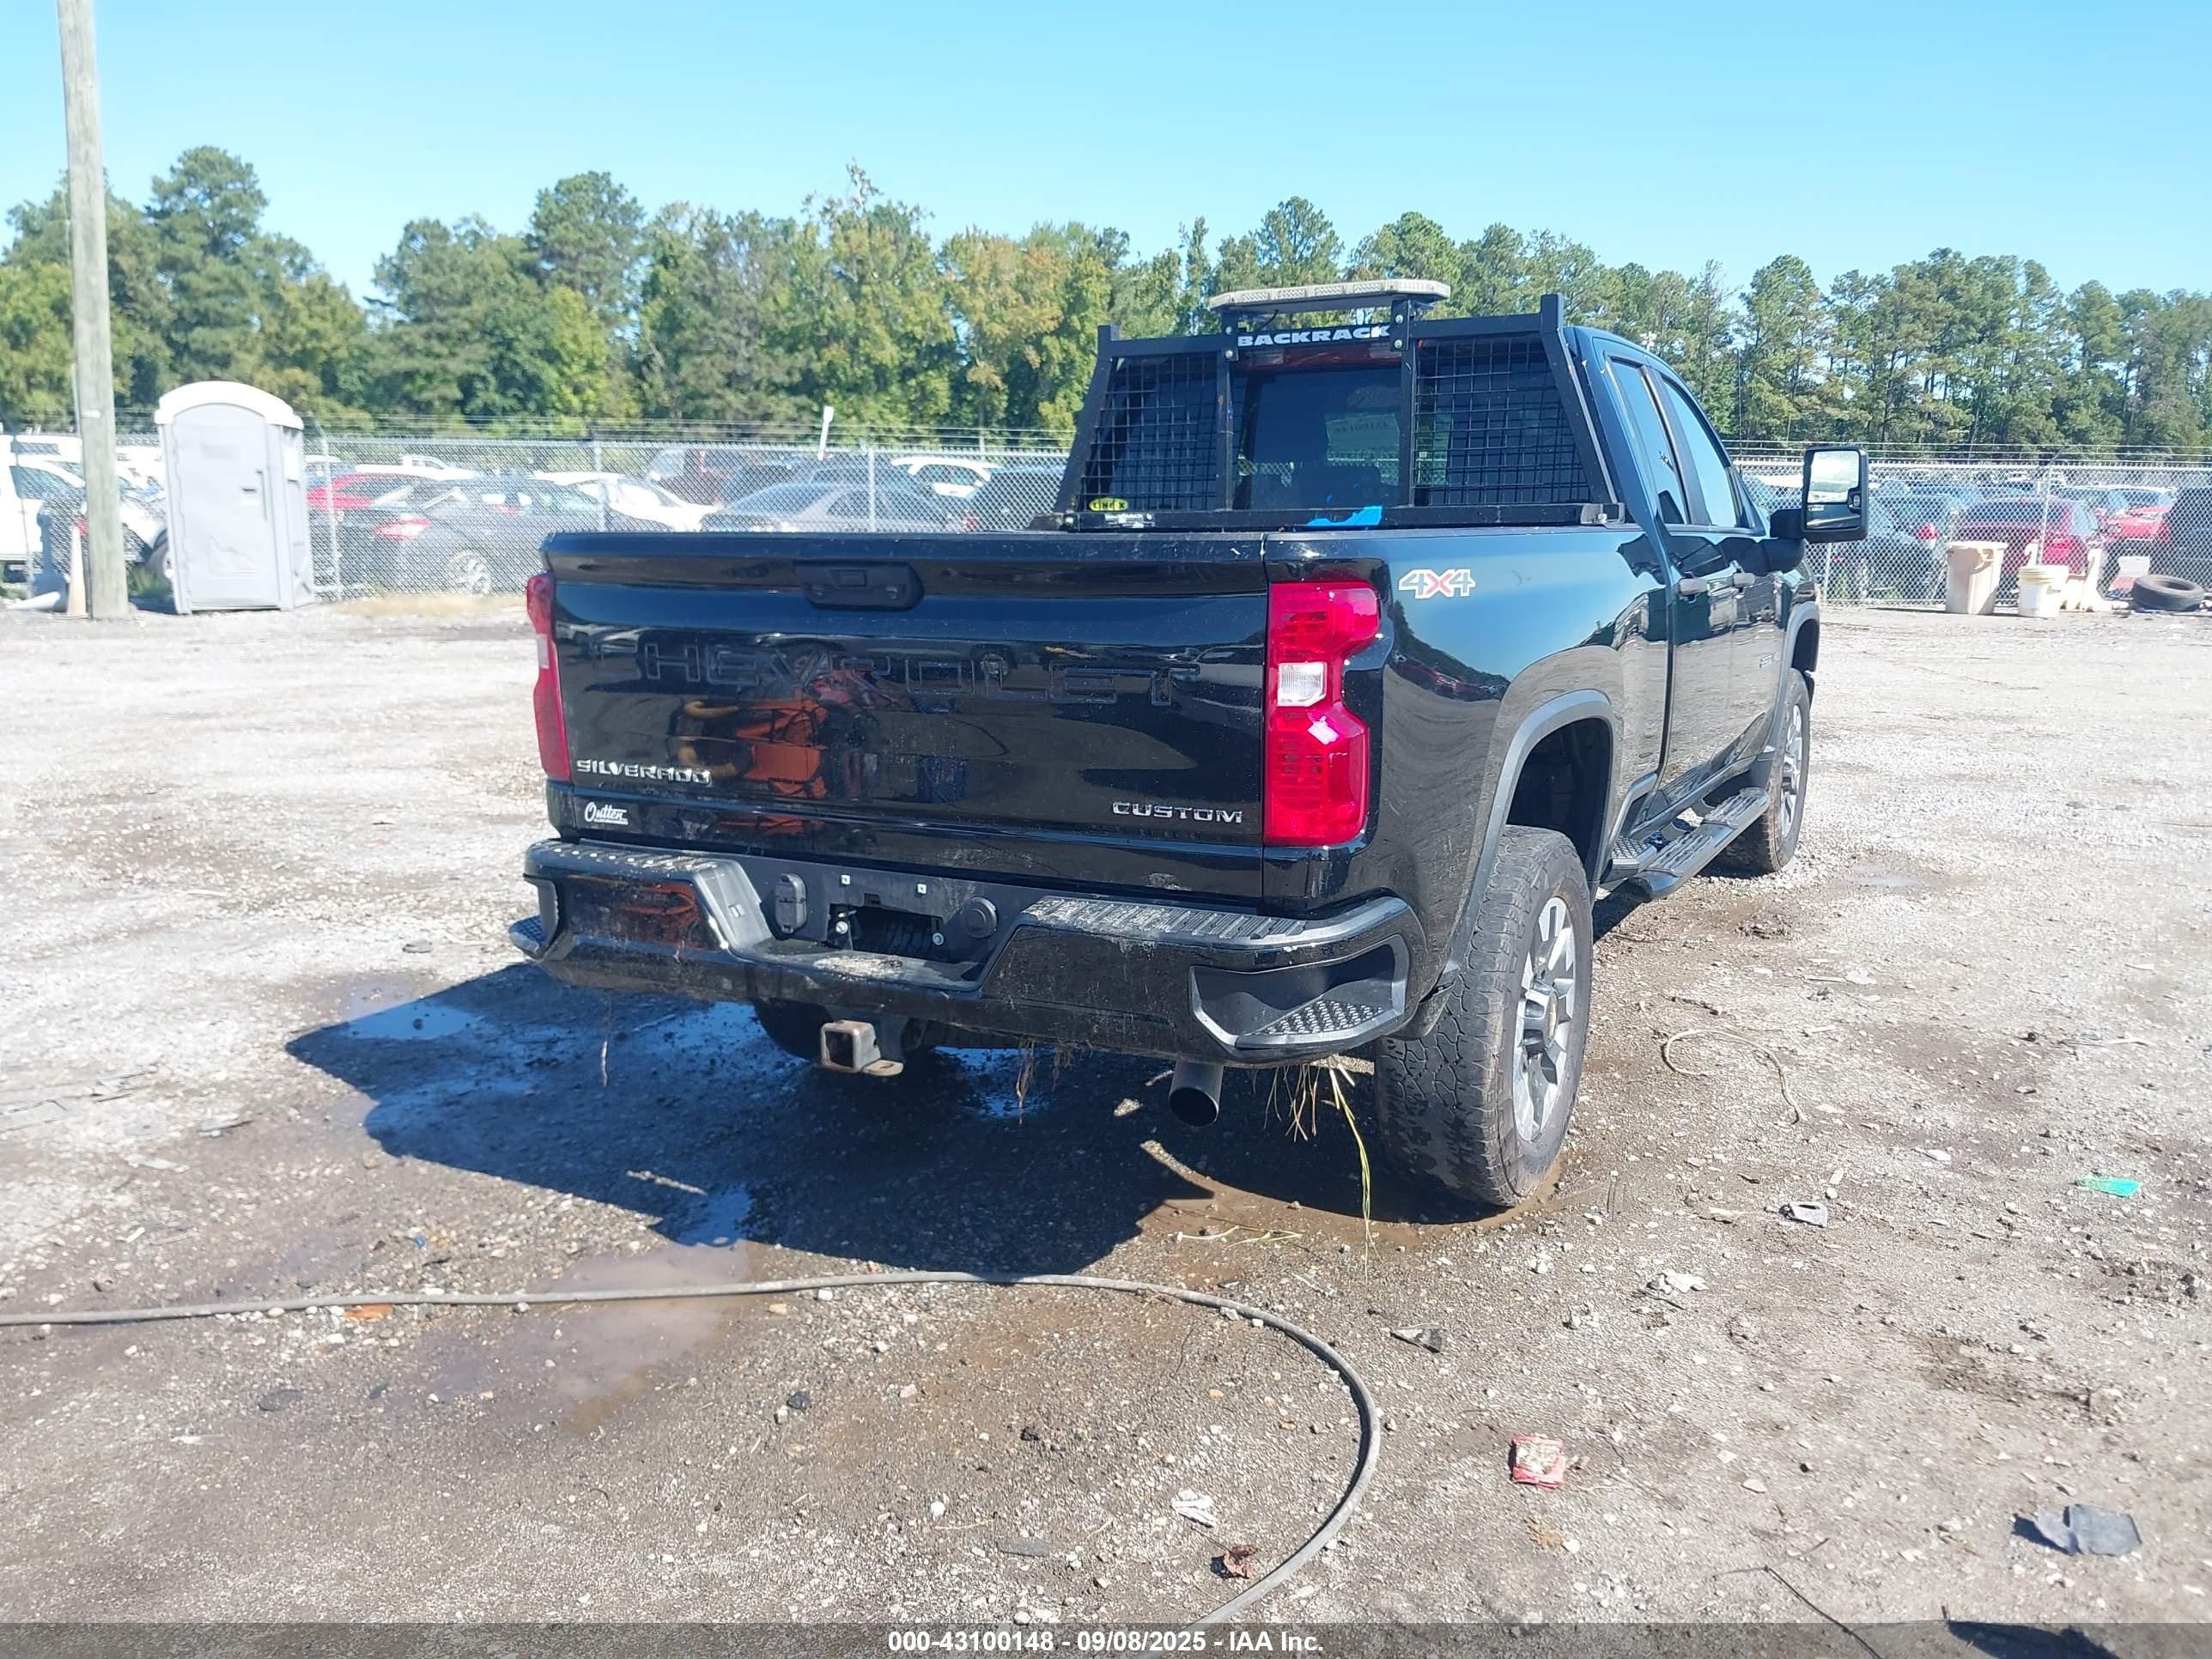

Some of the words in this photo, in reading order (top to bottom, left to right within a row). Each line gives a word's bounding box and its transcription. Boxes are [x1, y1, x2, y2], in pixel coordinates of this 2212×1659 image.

[1237, 325, 1390, 347] BACKRACK
[576, 759, 712, 787] SILVERADO
[1112, 801, 1243, 823] CUSTOM
